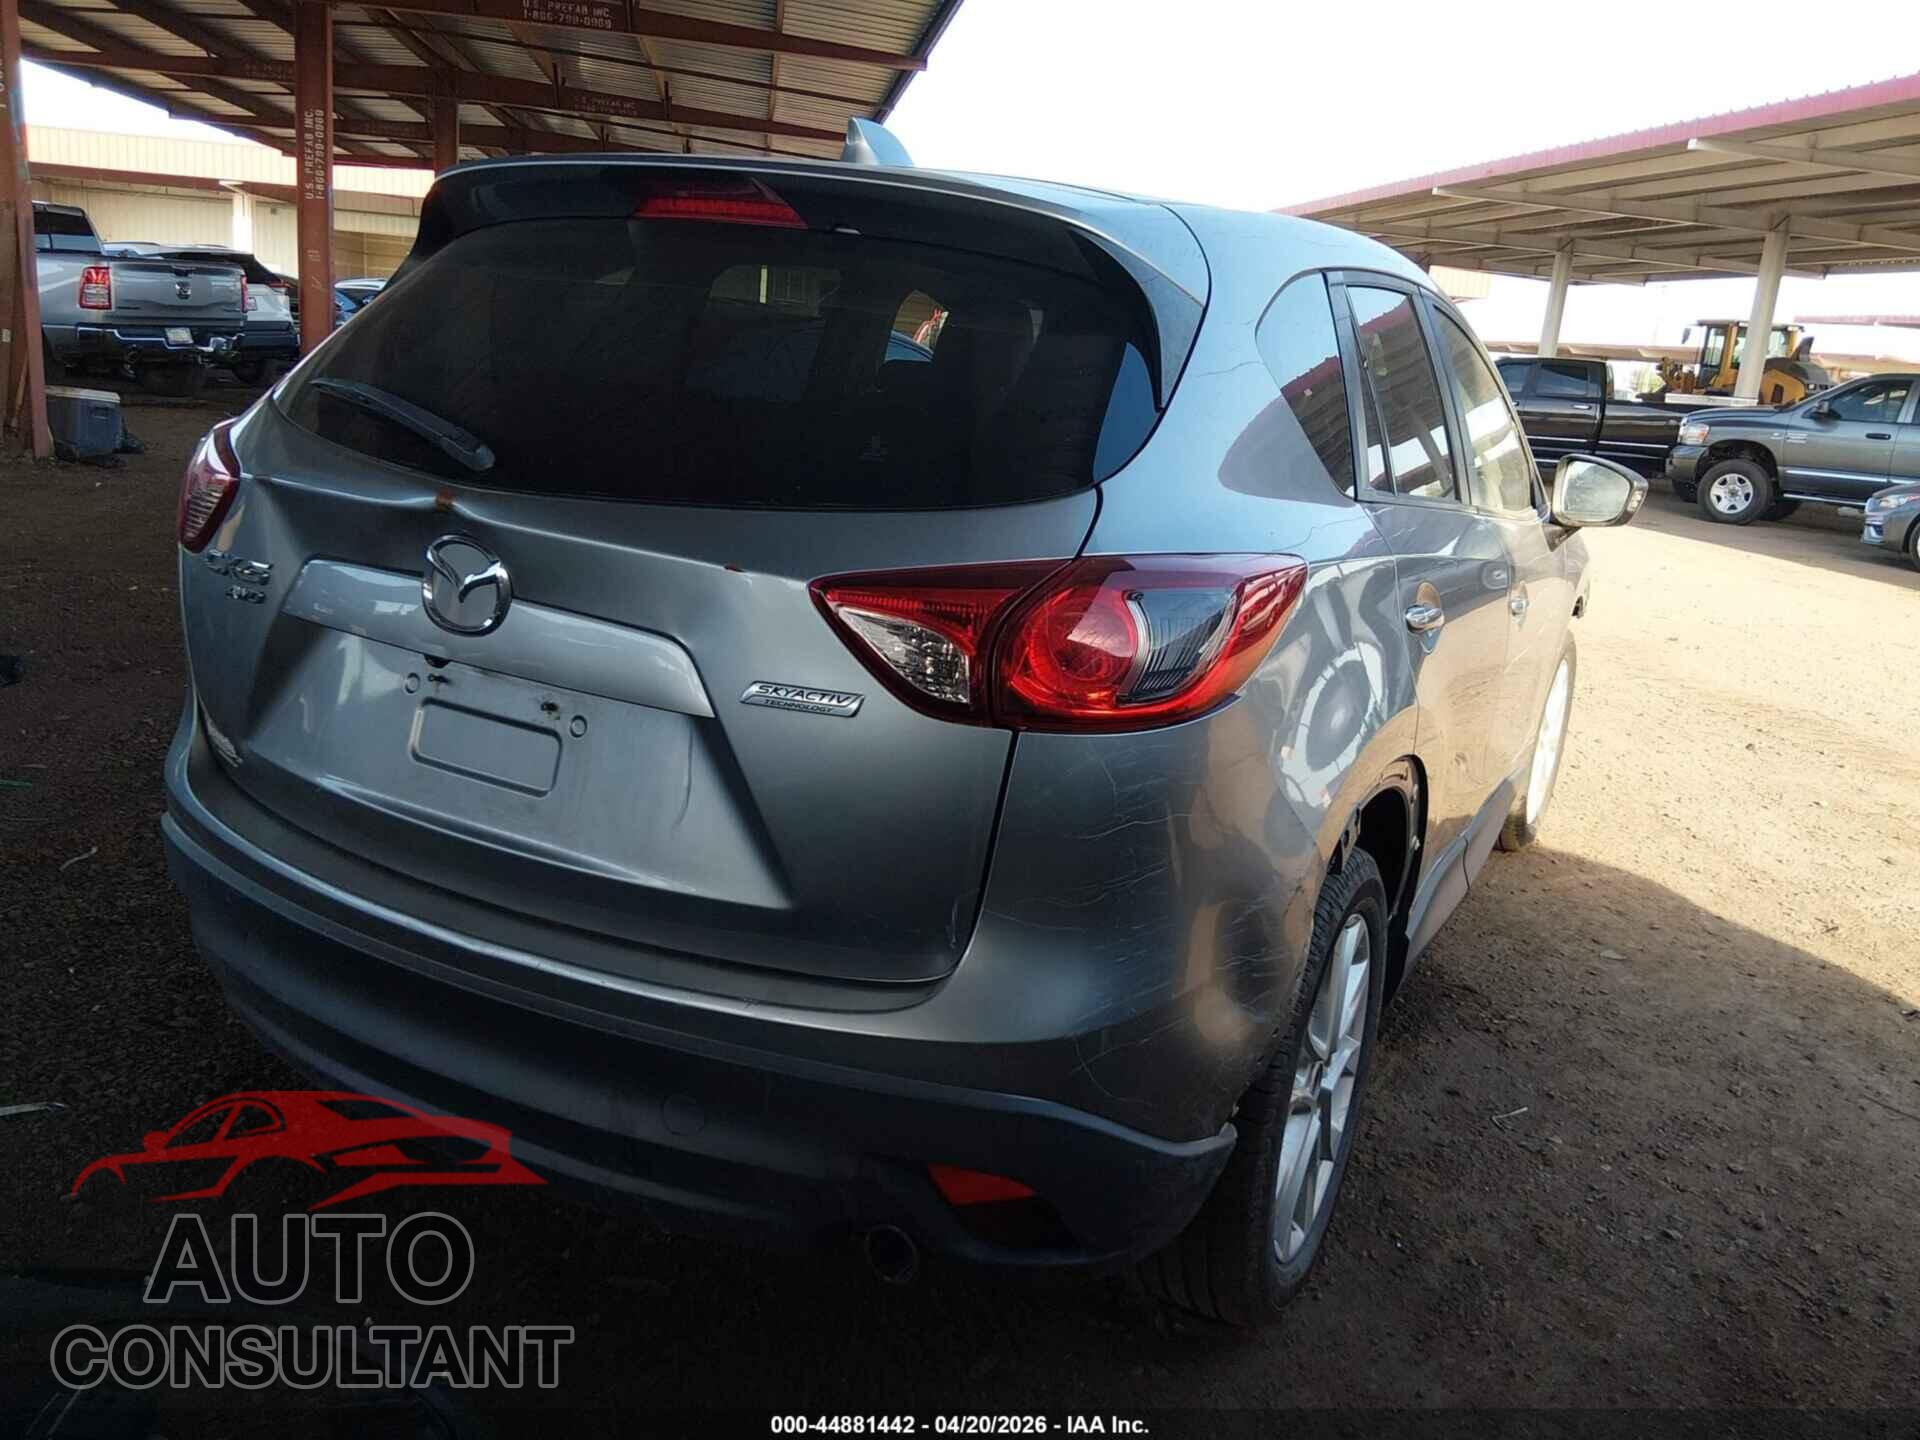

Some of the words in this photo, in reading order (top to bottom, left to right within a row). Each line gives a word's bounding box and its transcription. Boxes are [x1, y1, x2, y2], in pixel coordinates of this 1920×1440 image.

[304, 133, 314, 174] PREFAB
[755, 684, 851, 704] SKYACTIV
[764, 698, 834, 713] TECHNOLOGY
